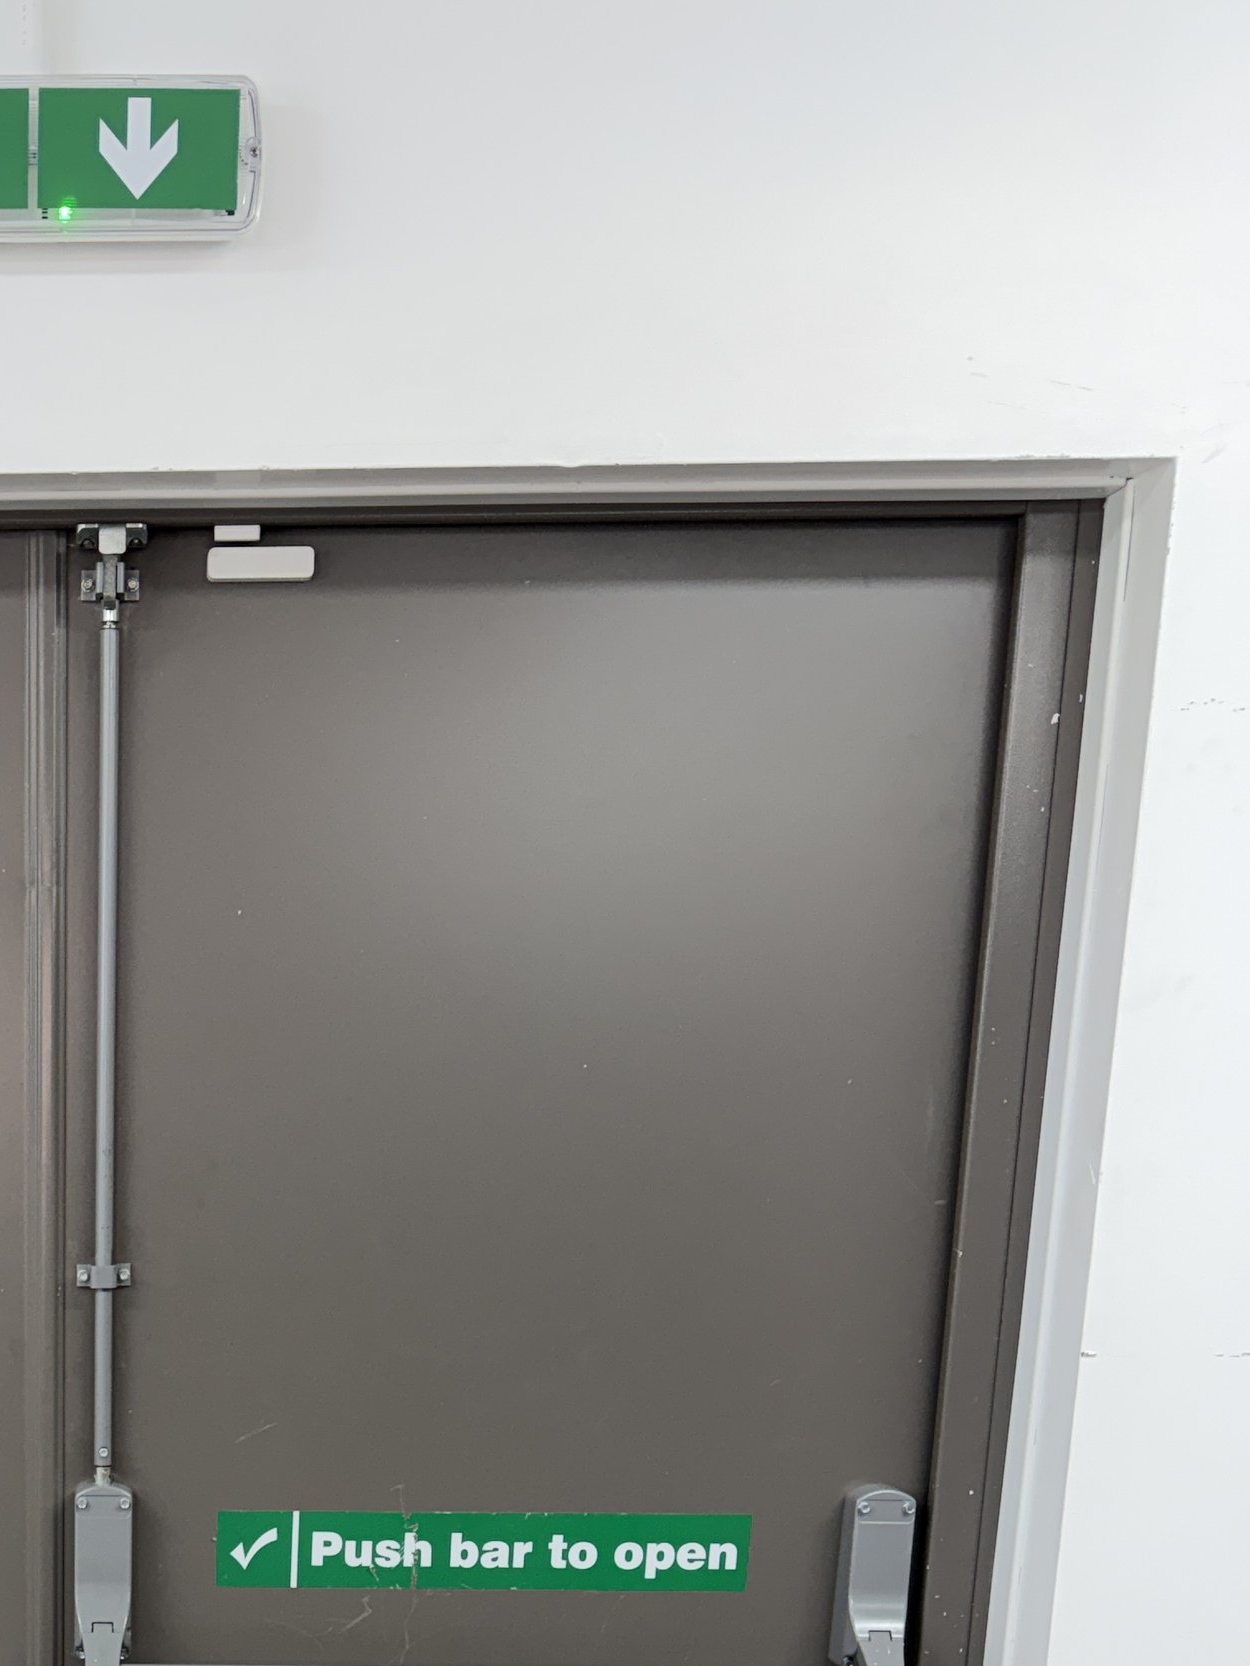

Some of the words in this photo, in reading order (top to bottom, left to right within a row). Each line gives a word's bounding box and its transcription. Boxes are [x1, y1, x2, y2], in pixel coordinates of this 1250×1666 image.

[310, 1531, 432, 1569] Push
[449, 1532, 533, 1569] bar
[548, 1534, 598, 1570] to
[613, 1541, 738, 1579] open
